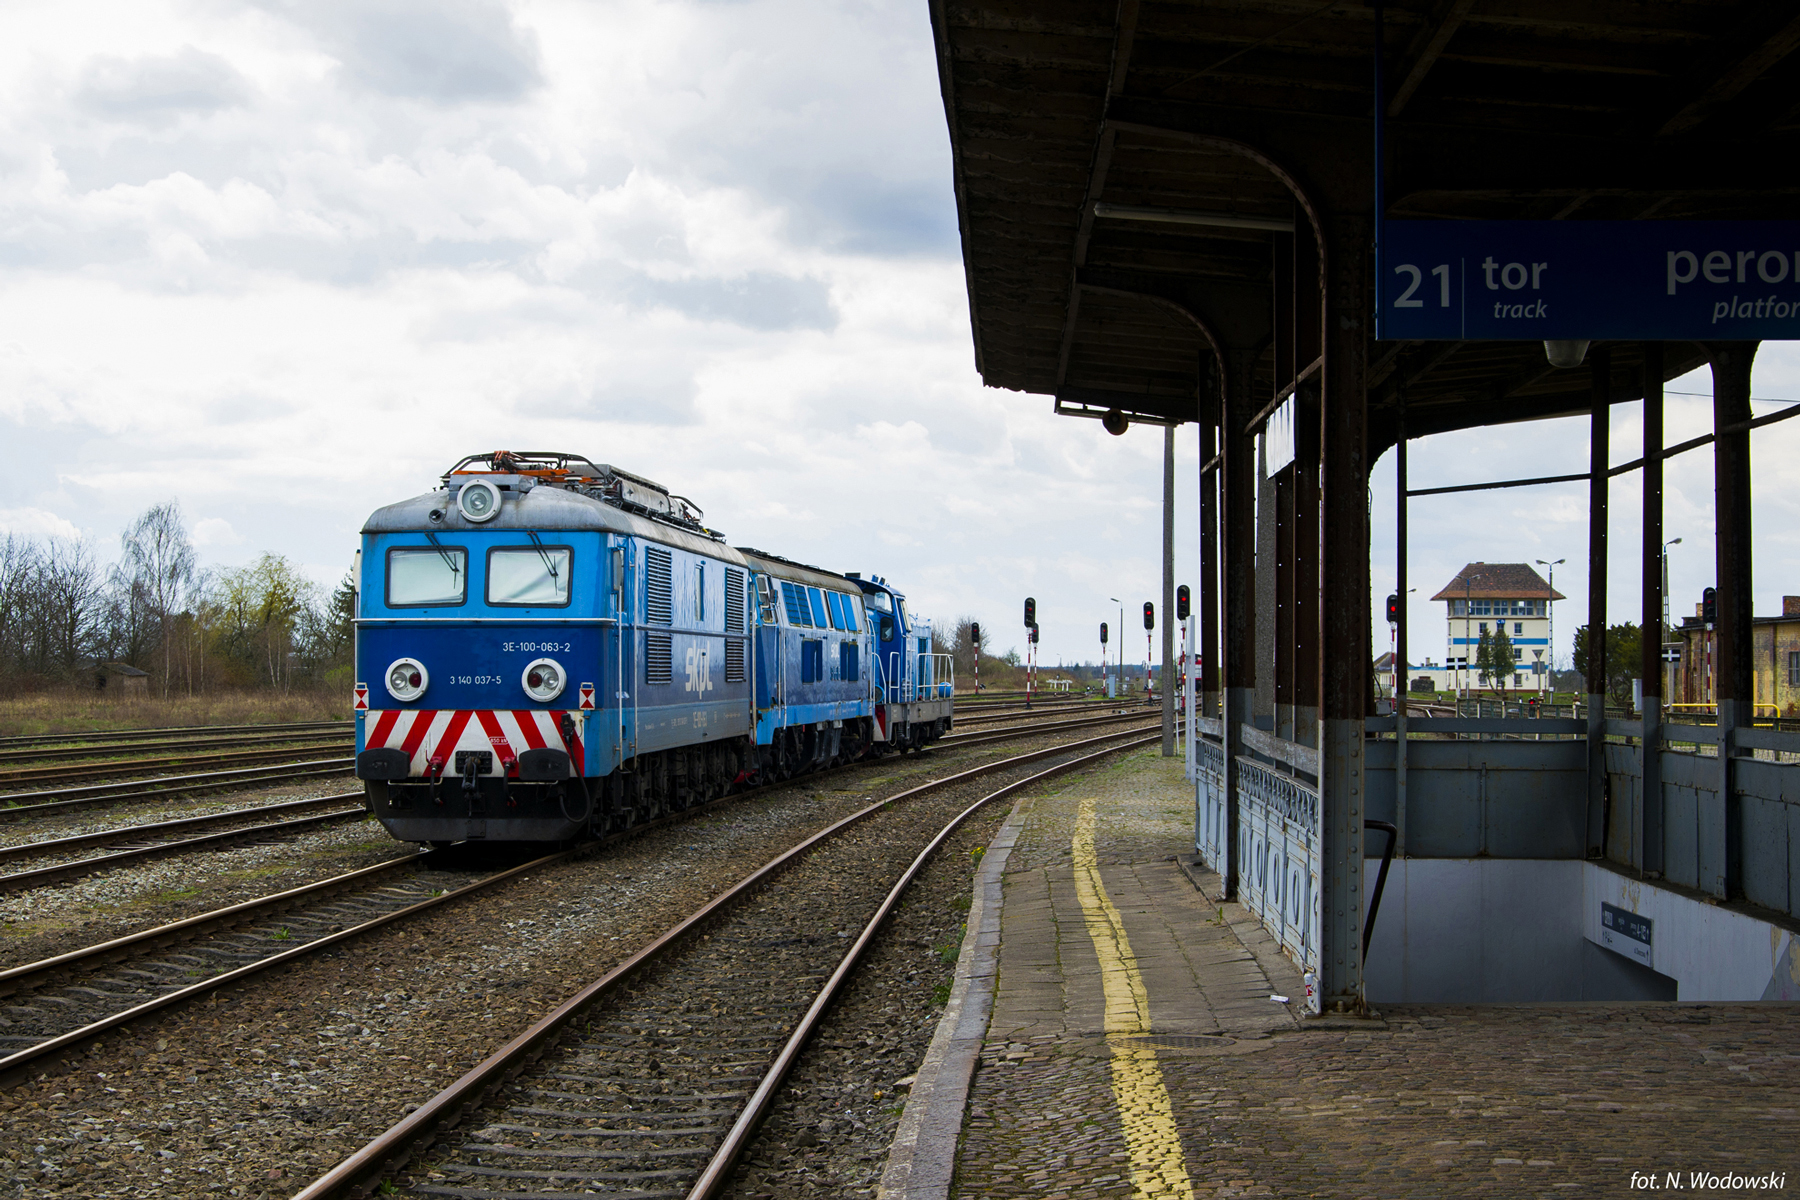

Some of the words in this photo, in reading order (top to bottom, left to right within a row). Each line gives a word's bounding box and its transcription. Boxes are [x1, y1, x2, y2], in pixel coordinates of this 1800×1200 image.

[1482, 256, 1548, 290] tor
[1393, 263, 1450, 308] 21
[1494, 298, 1548, 319] track
[502, 642, 571, 653] 3E-100-063-2
[450, 675, 455, 685] 3
[458, 675, 472, 685] 140
[474, 675, 502, 685] 037-5
